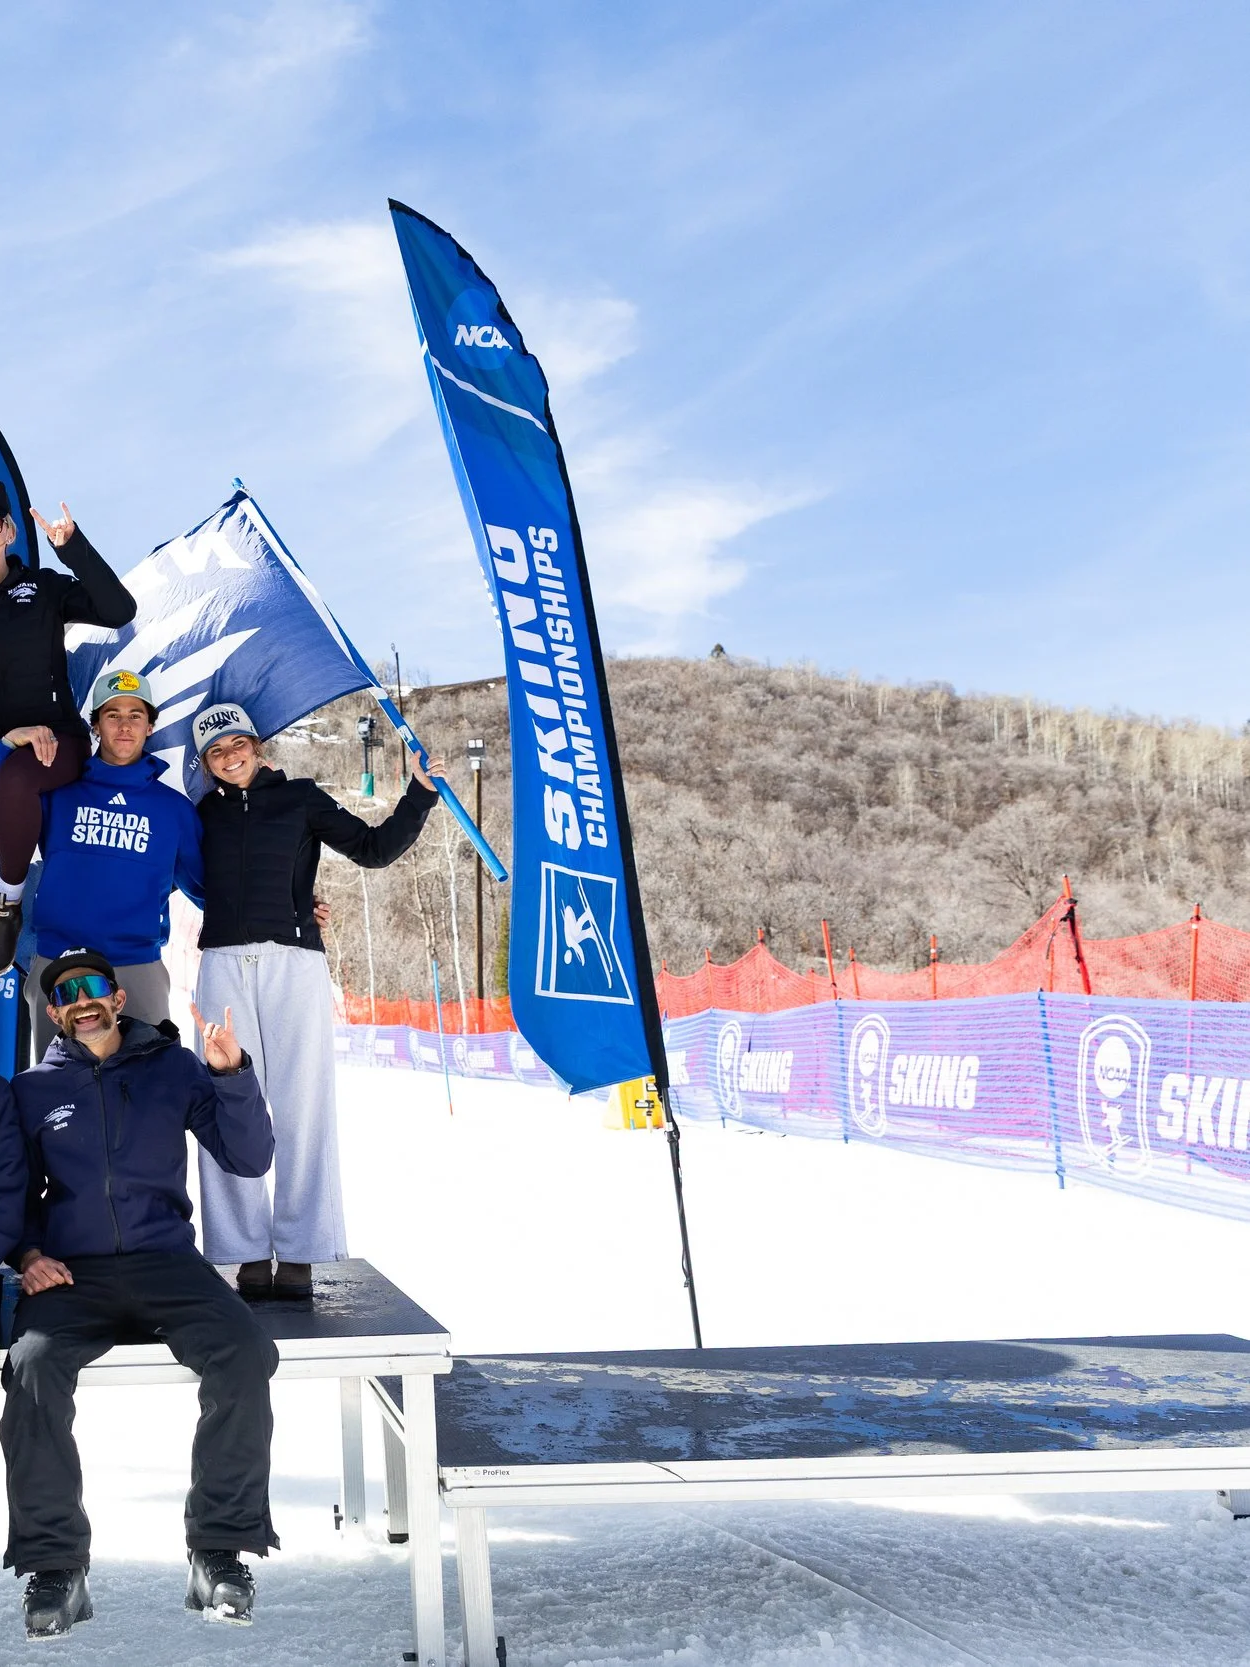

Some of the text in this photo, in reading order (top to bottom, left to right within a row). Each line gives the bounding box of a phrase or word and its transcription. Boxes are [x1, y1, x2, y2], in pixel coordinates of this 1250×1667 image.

[485, 524, 582, 850] SKIING
[527, 525, 608, 849] CHAMPIONSHIPS
[199, 710, 240, 736] SKIING
[71, 824, 149, 853] SKIING
[75, 806, 150, 834] NEVADA
[739, 1050, 794, 1094] SKIING
[888, 1054, 980, 1111] SKIING
